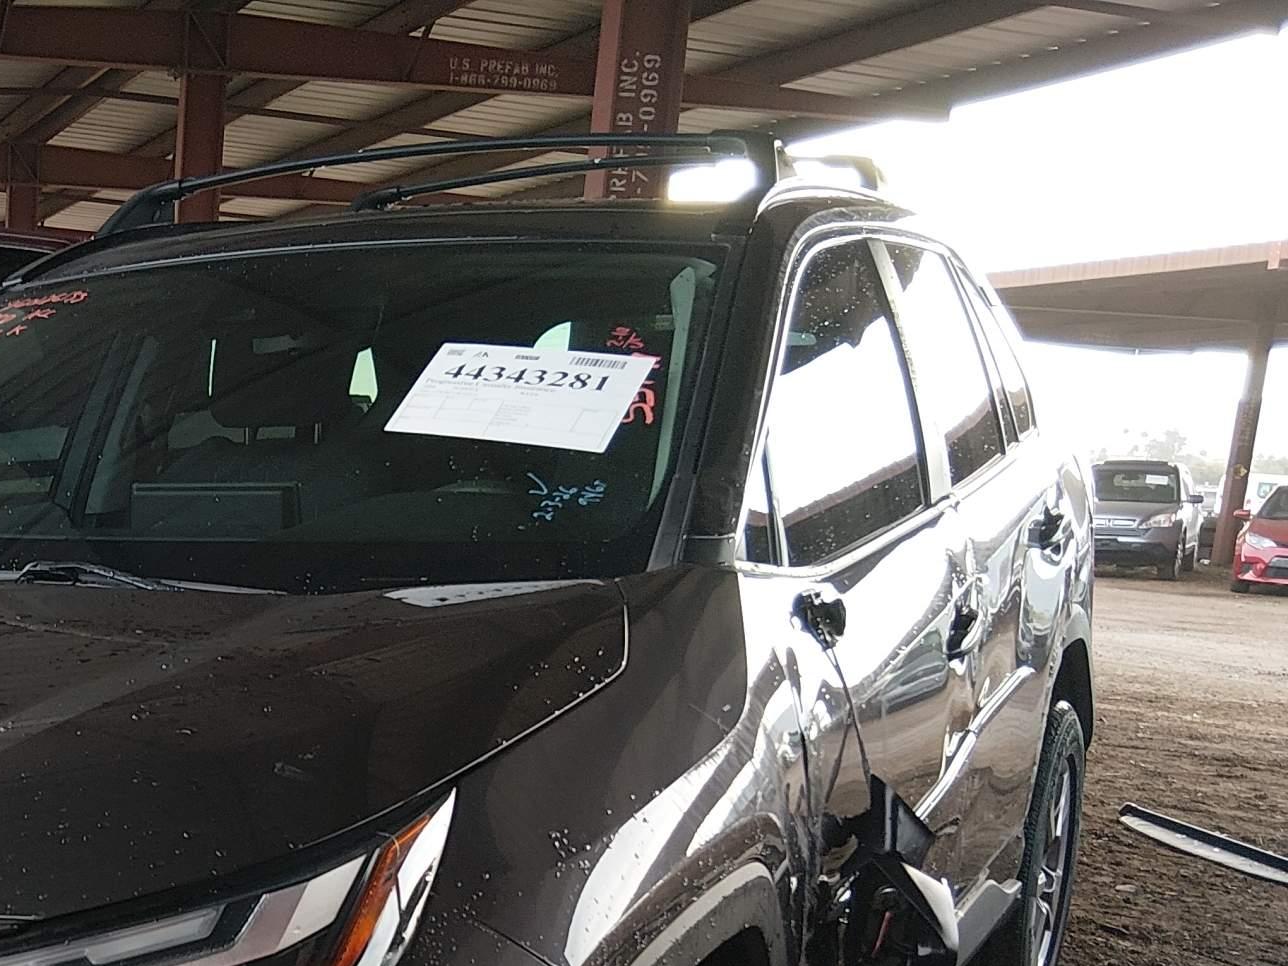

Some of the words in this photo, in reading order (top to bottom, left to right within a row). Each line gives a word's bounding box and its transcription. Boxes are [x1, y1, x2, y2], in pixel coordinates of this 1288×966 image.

[480, 59, 530, 75] PREFAB
[617, 50, 640, 98] INC.
[444, 362, 610, 392] 44343281
